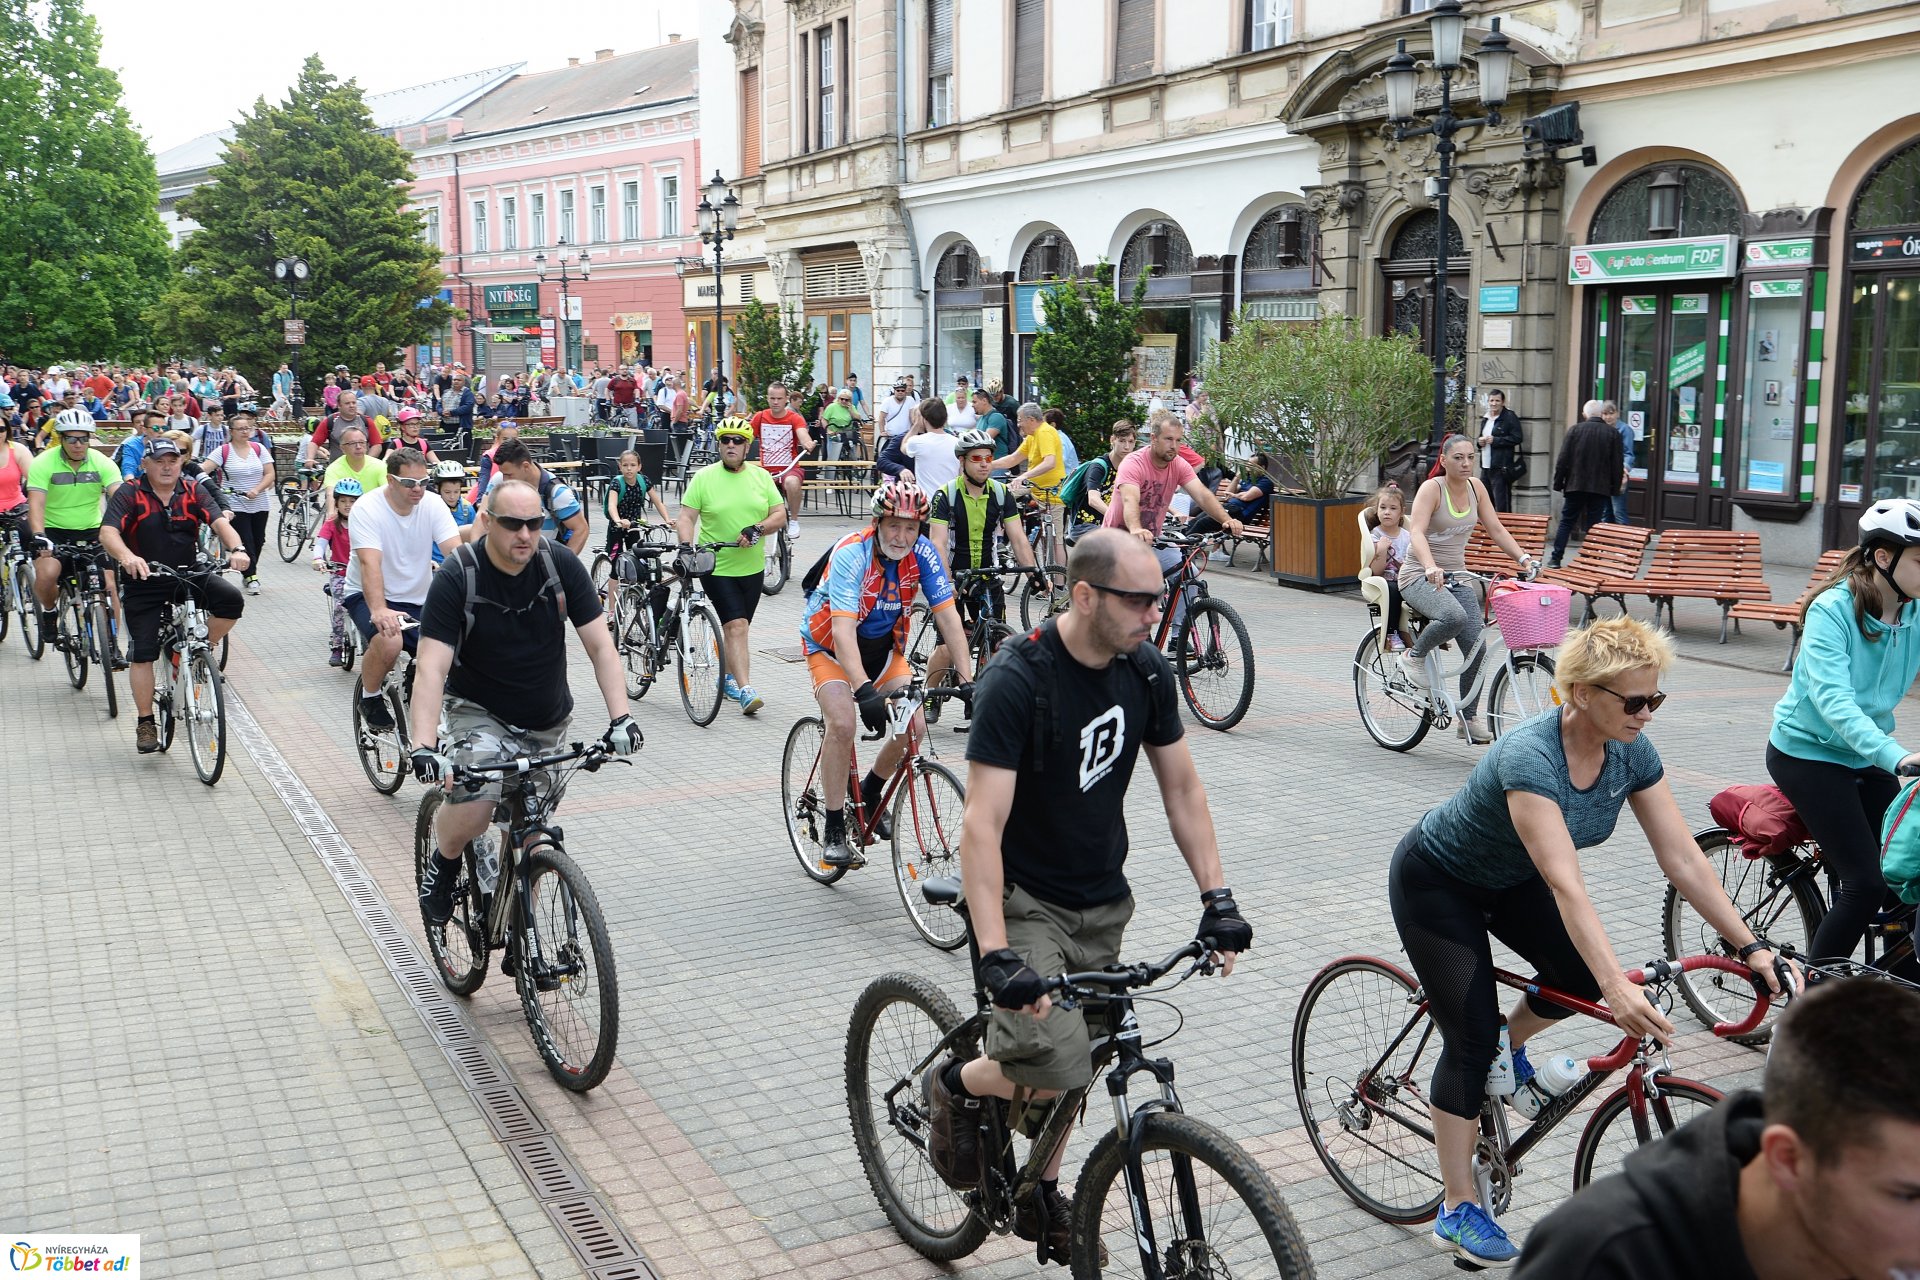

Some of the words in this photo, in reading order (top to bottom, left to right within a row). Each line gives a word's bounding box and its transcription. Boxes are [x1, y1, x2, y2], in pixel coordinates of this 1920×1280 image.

[1691, 248, 1720, 264] FDF
[1791, 247, 1808, 257] FDF
[1607, 256, 1625, 270] Fuji
[1625, 255, 1645, 267] Foto
[1646, 253, 1685, 266] Centrum
[489, 286, 532, 304] NYÍRSÉG
